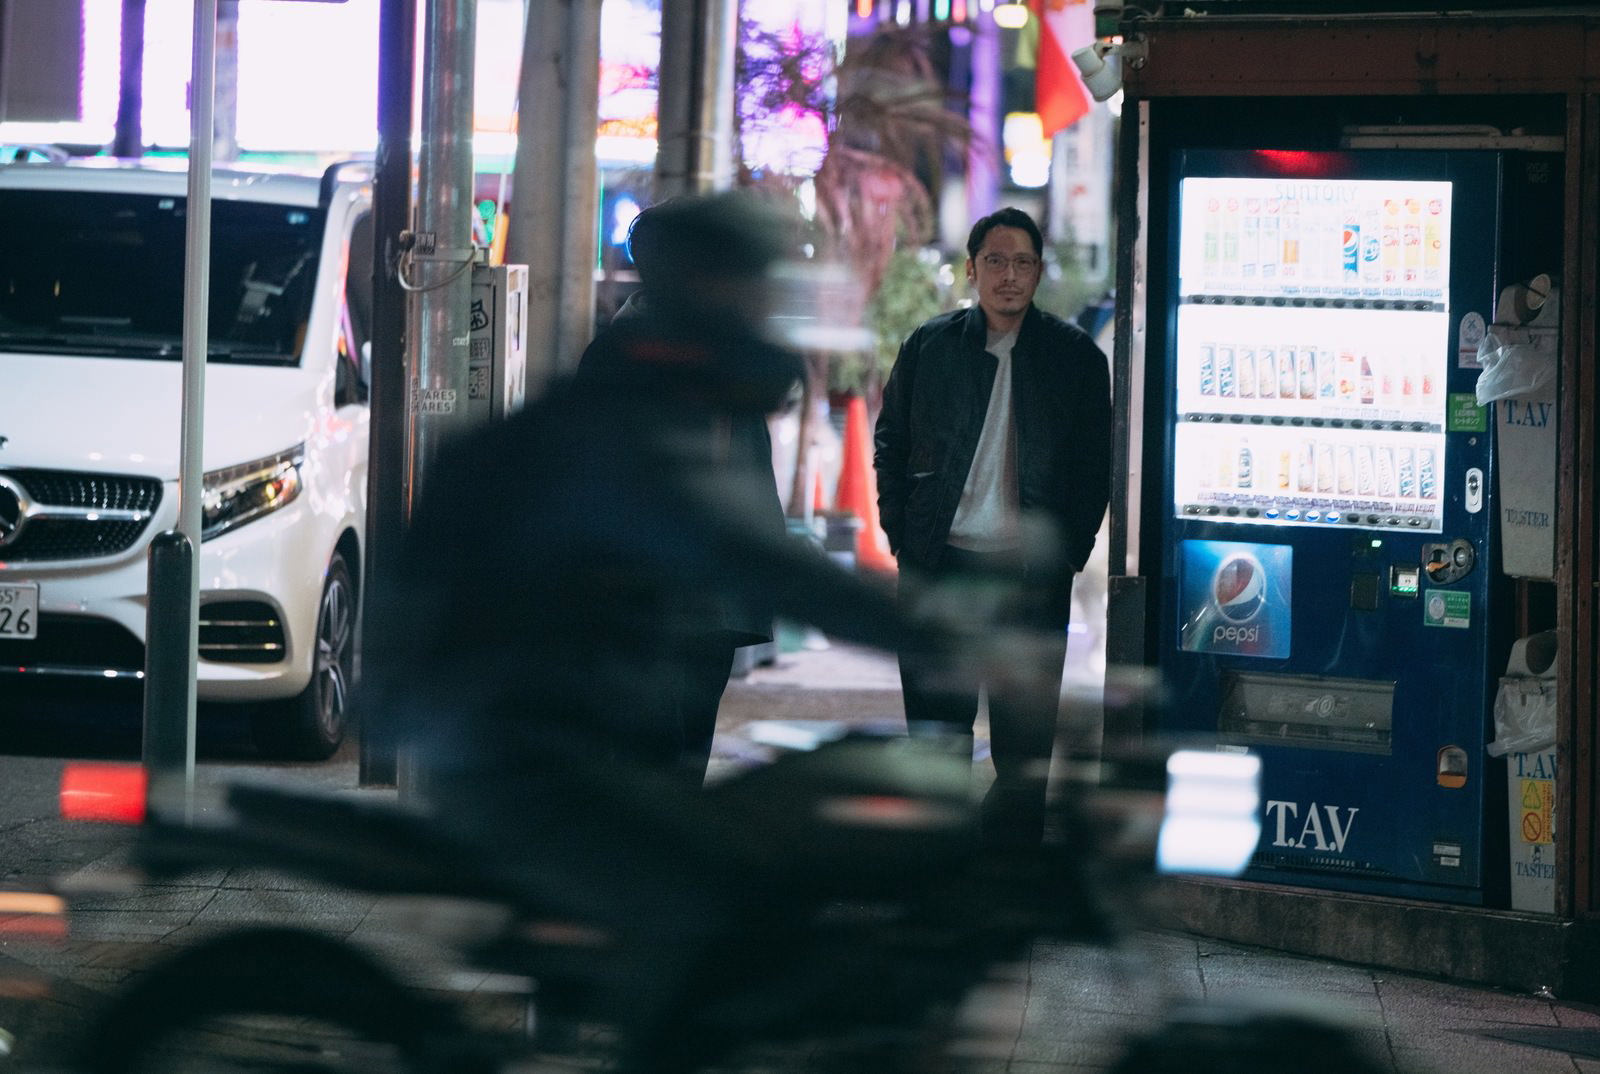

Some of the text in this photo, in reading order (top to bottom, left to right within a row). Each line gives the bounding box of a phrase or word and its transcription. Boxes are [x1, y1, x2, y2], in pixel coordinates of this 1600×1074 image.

[1274, 183, 1358, 202] SUNTORY
[1503, 399, 1552, 428] T.A.V
[1213, 624, 1259, 645] pepsi
[1266, 800, 1360, 854] T.A.V
